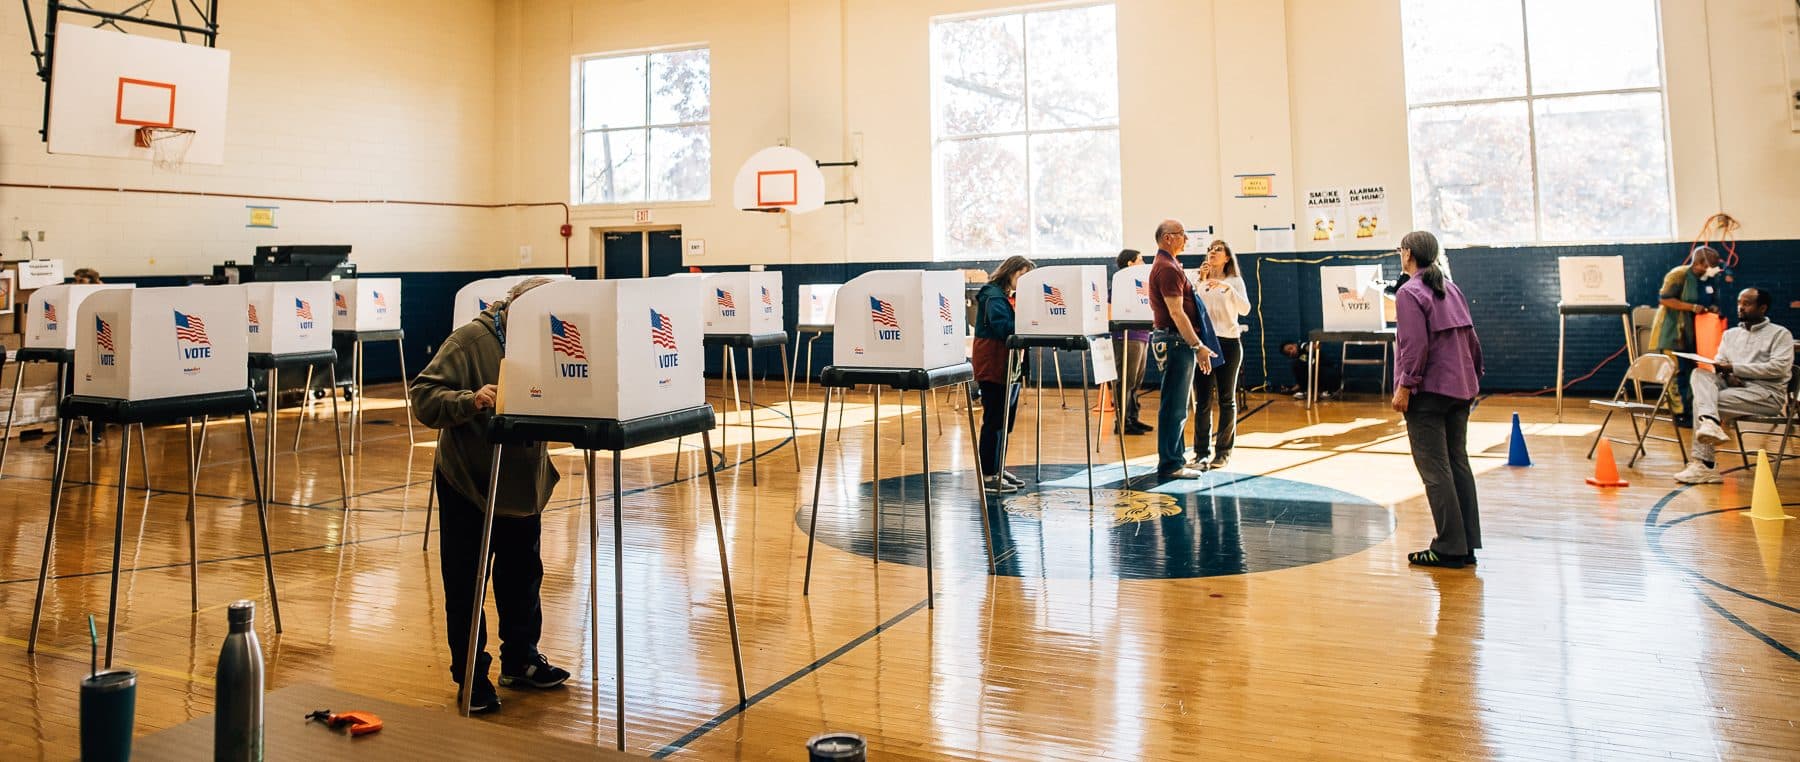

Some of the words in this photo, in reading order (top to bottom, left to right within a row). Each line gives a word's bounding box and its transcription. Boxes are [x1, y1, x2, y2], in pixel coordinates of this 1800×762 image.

[1309, 190, 1339, 199] SMOKE
[1349, 186, 1384, 195] ALARMAS
[1308, 197, 1341, 205] ALARMS
[1361, 193, 1385, 201] HUMO
[636, 210, 649, 221] EXIT
[722, 309, 736, 317] VOTE
[1050, 307, 1067, 316] VOTE
[249, 325, 259, 333] OTE
[300, 321, 314, 330] VOTE
[879, 329, 901, 340] VOTE
[184, 347, 211, 359] VOTE
[101, 354, 115, 366] VOTE
[659, 353, 679, 369] VOTE
[561, 363, 588, 379] VOTE
